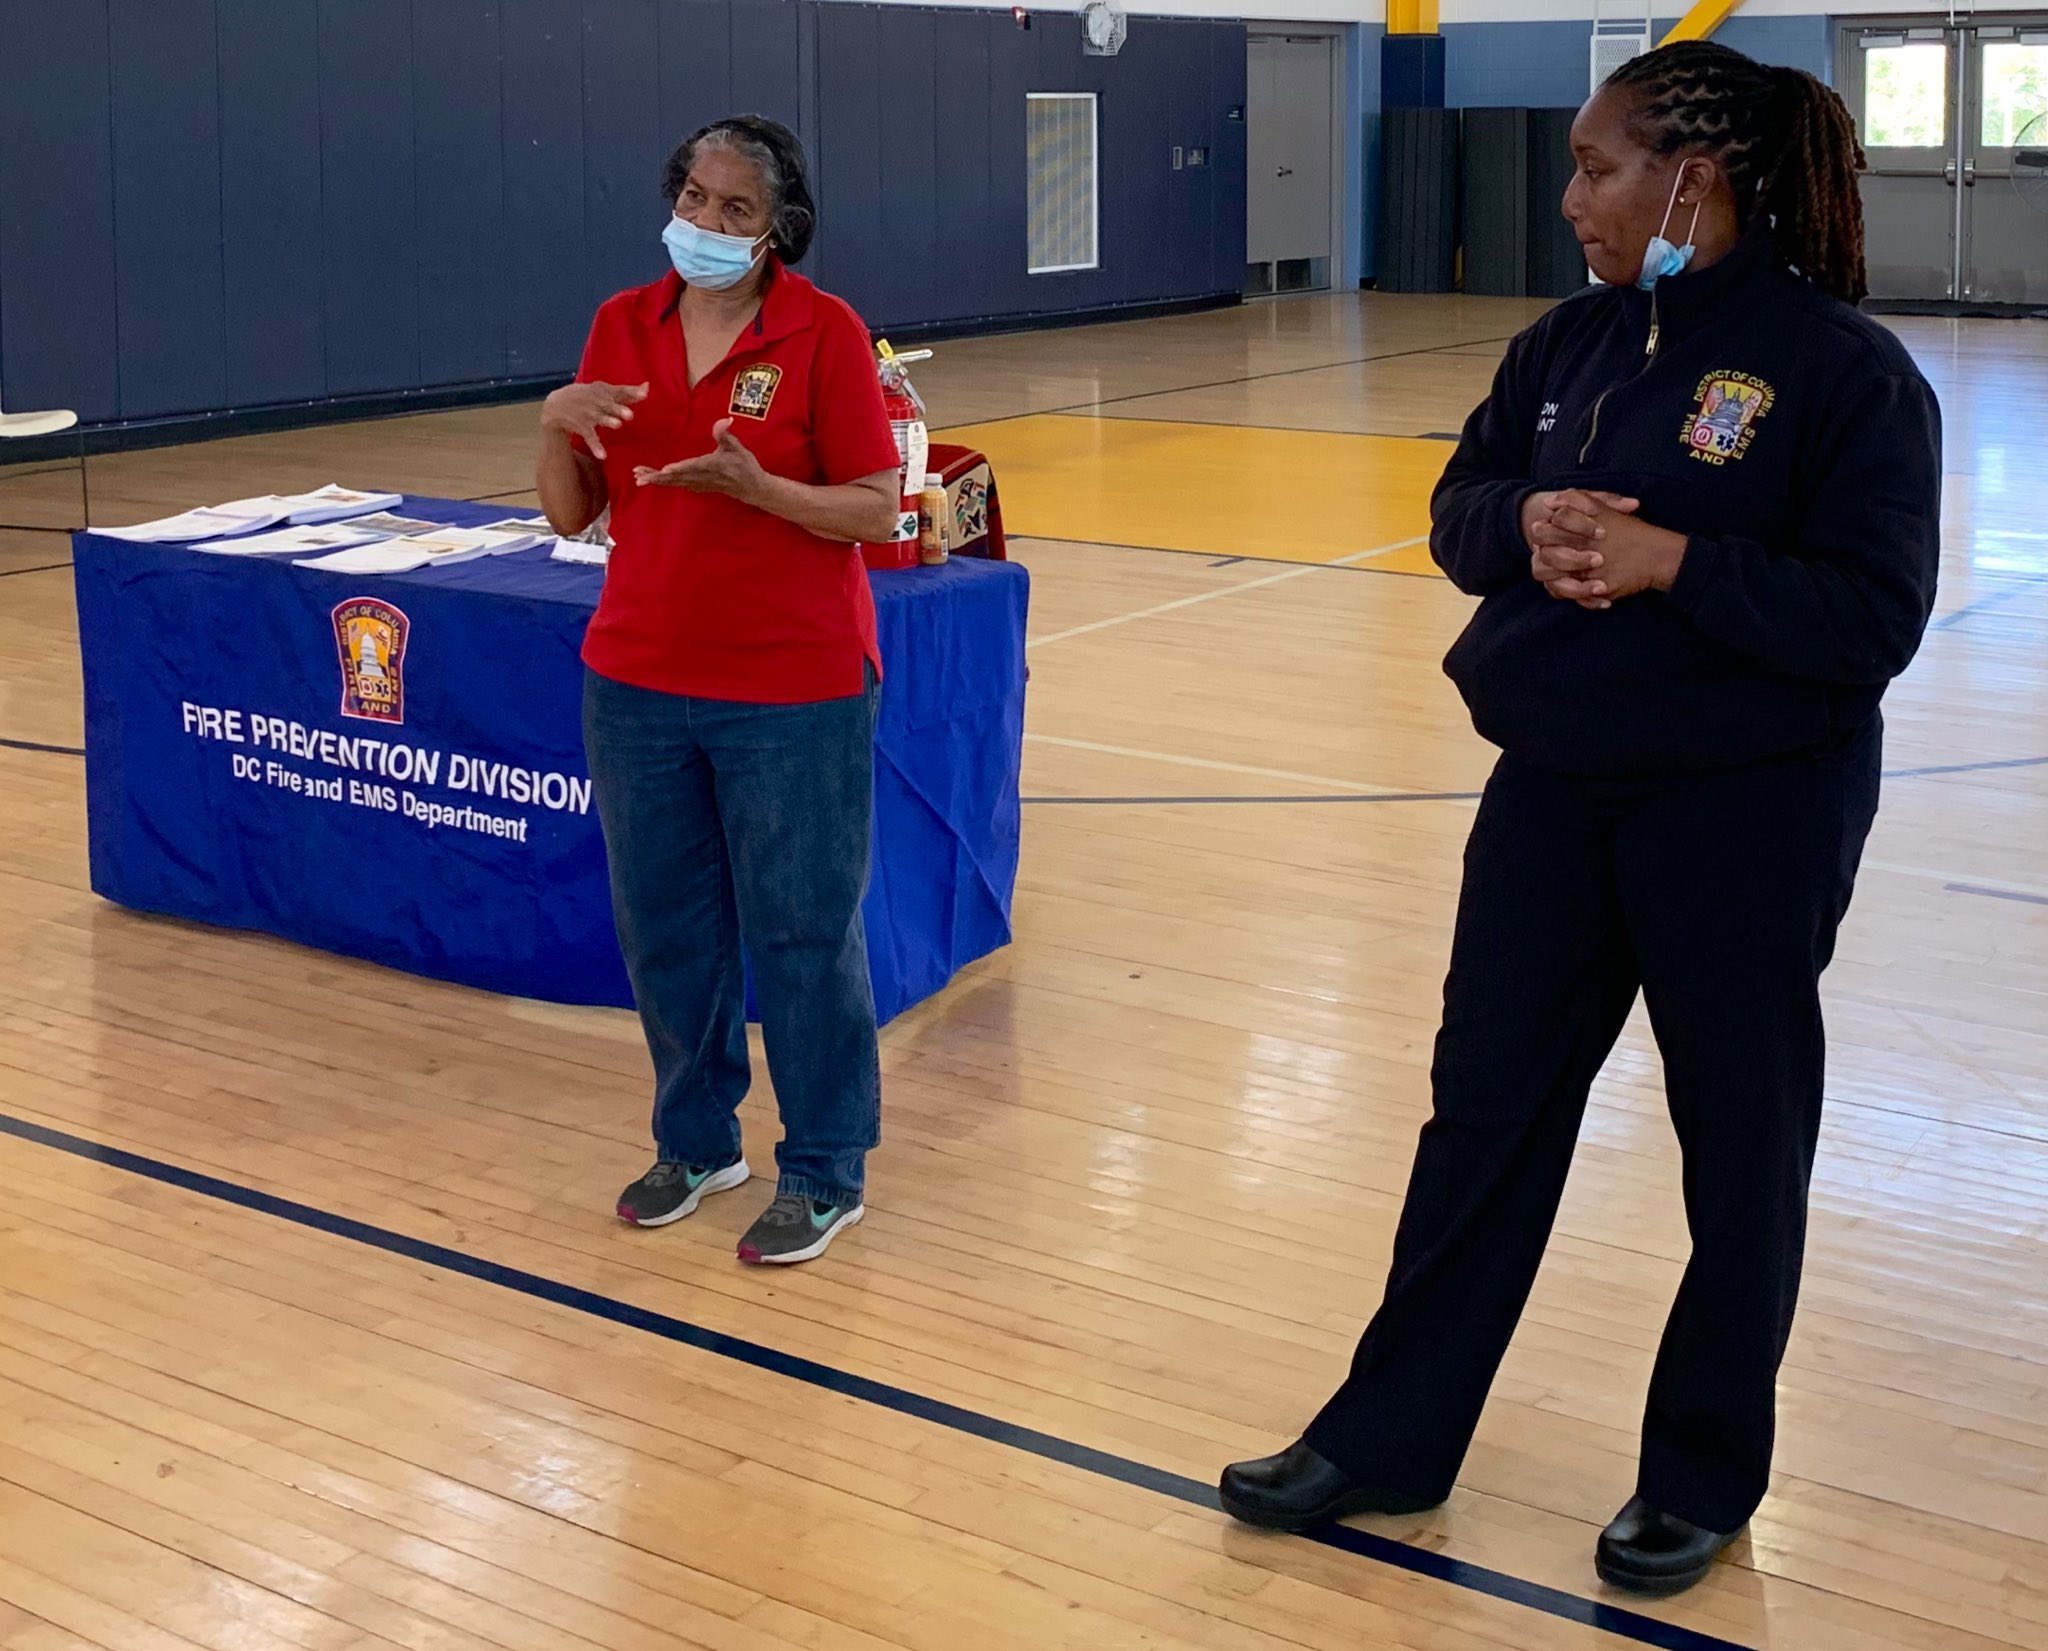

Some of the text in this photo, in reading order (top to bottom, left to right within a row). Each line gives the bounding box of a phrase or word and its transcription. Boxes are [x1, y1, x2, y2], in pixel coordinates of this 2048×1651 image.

[1693, 369, 1776, 418] DISTRICT OF COLUMBIA
[1679, 413, 1697, 444] FIRE
[1732, 427, 1756, 460] EMS
[1689, 449, 1725, 466] AND
[359, 605, 372, 617] OF
[361, 701, 391, 713] AND
[182, 700, 592, 815] FIRE PREVENTION DIVISION
[233, 754, 528, 843] DC Fire and EMS Department
